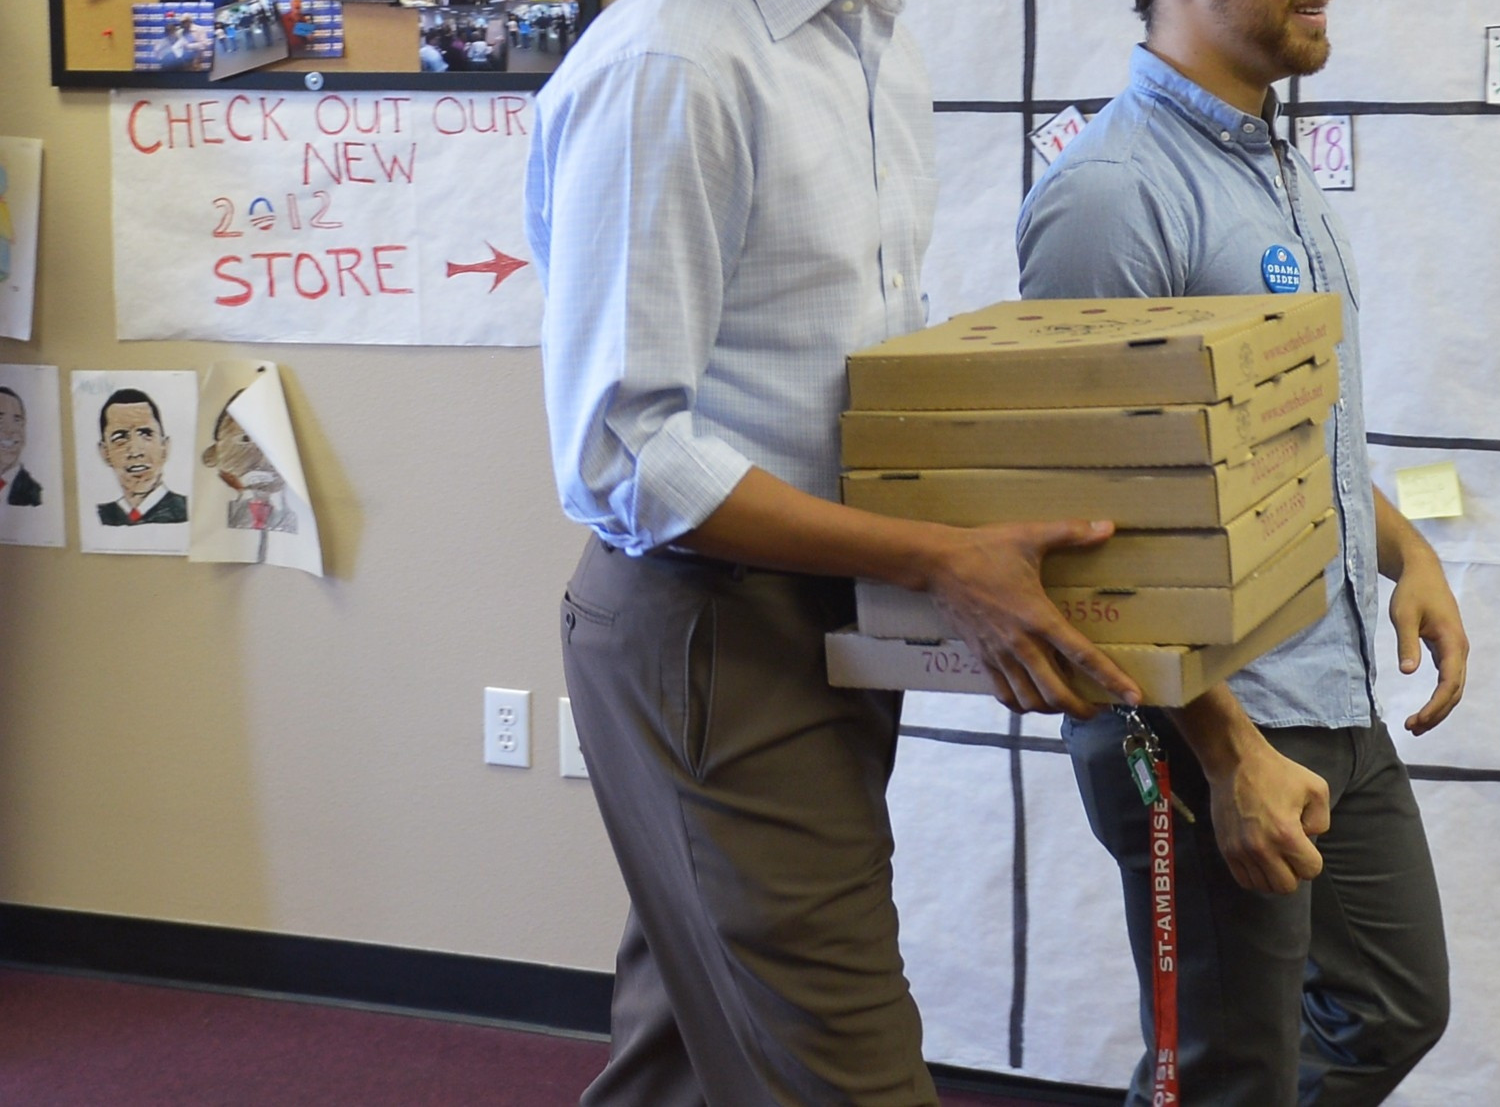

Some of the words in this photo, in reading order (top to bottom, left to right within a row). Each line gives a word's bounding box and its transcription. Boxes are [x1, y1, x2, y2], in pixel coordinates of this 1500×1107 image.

[127, 94, 289, 154] CHECK
[315, 94, 411, 136] OUT
[432, 95, 528, 136] OUR
[302, 141, 417, 185] NEW
[1303, 125, 1346, 173] 18
[212, 190, 344, 239] 2012
[213, 245, 414, 307] STORE
[1267, 264, 1300, 275] OBAMA
[1269, 275, 1299, 285] BIDEN
[1152, 797, 1174, 973] ST-AMBROISE
